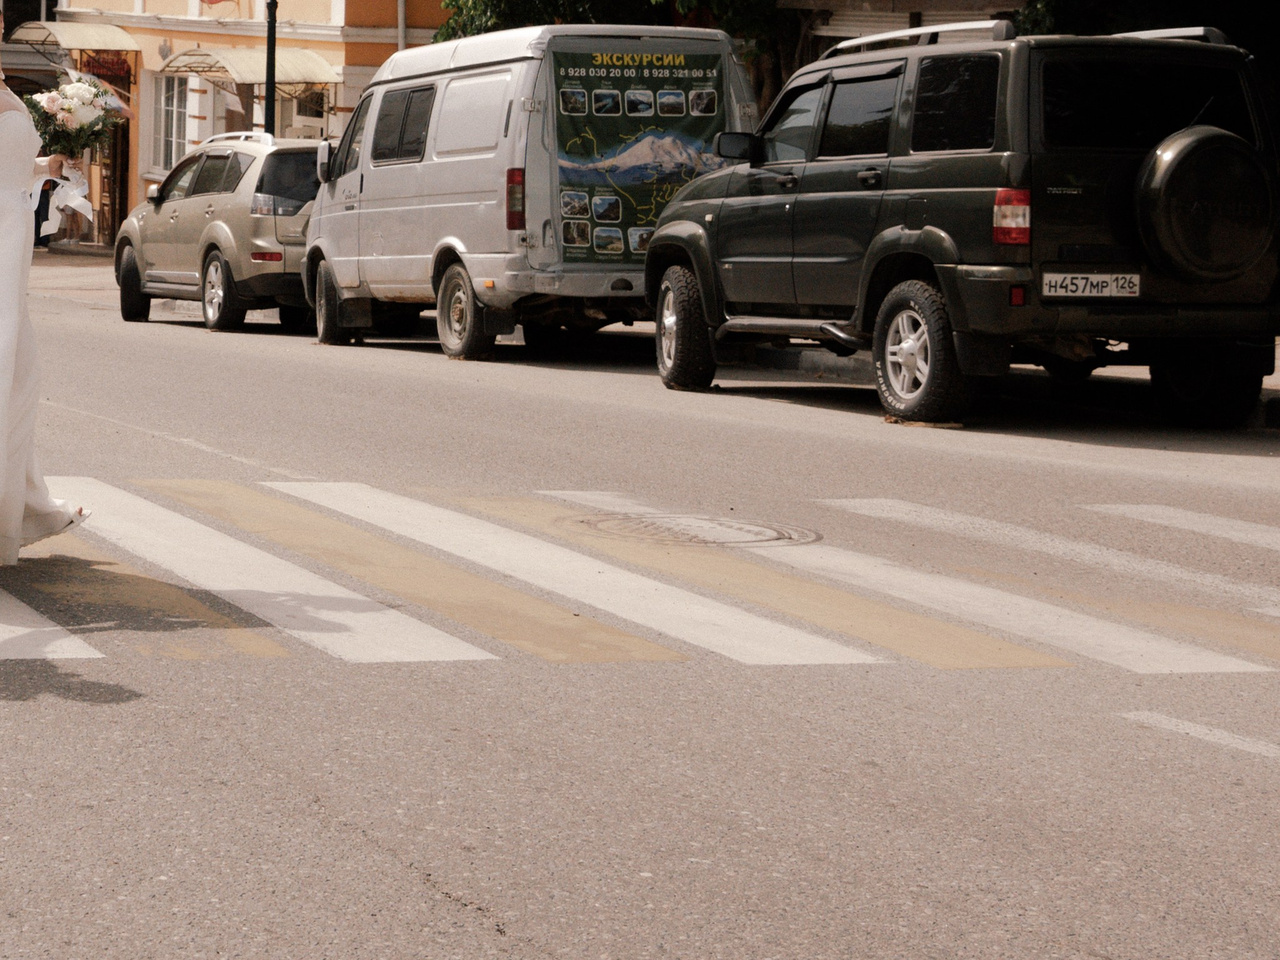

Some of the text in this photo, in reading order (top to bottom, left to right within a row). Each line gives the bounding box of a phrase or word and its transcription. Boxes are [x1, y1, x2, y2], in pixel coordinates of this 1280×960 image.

[592, 53, 685, 66] ЭКСКУРСИИ
[560, 67, 565, 76] 8
[568, 68, 586, 76] 928
[589, 68, 607, 77] 030
[609, 68, 621, 77] 20
[623, 68, 636, 77] 00
[643, 69, 649, 77] 8
[652, 69, 670, 77] 928
[672, 69, 688, 77] 321
[691, 69, 704, 77] 00
[706, 69, 717, 77] 51
[1112, 276, 1135, 289] 126
